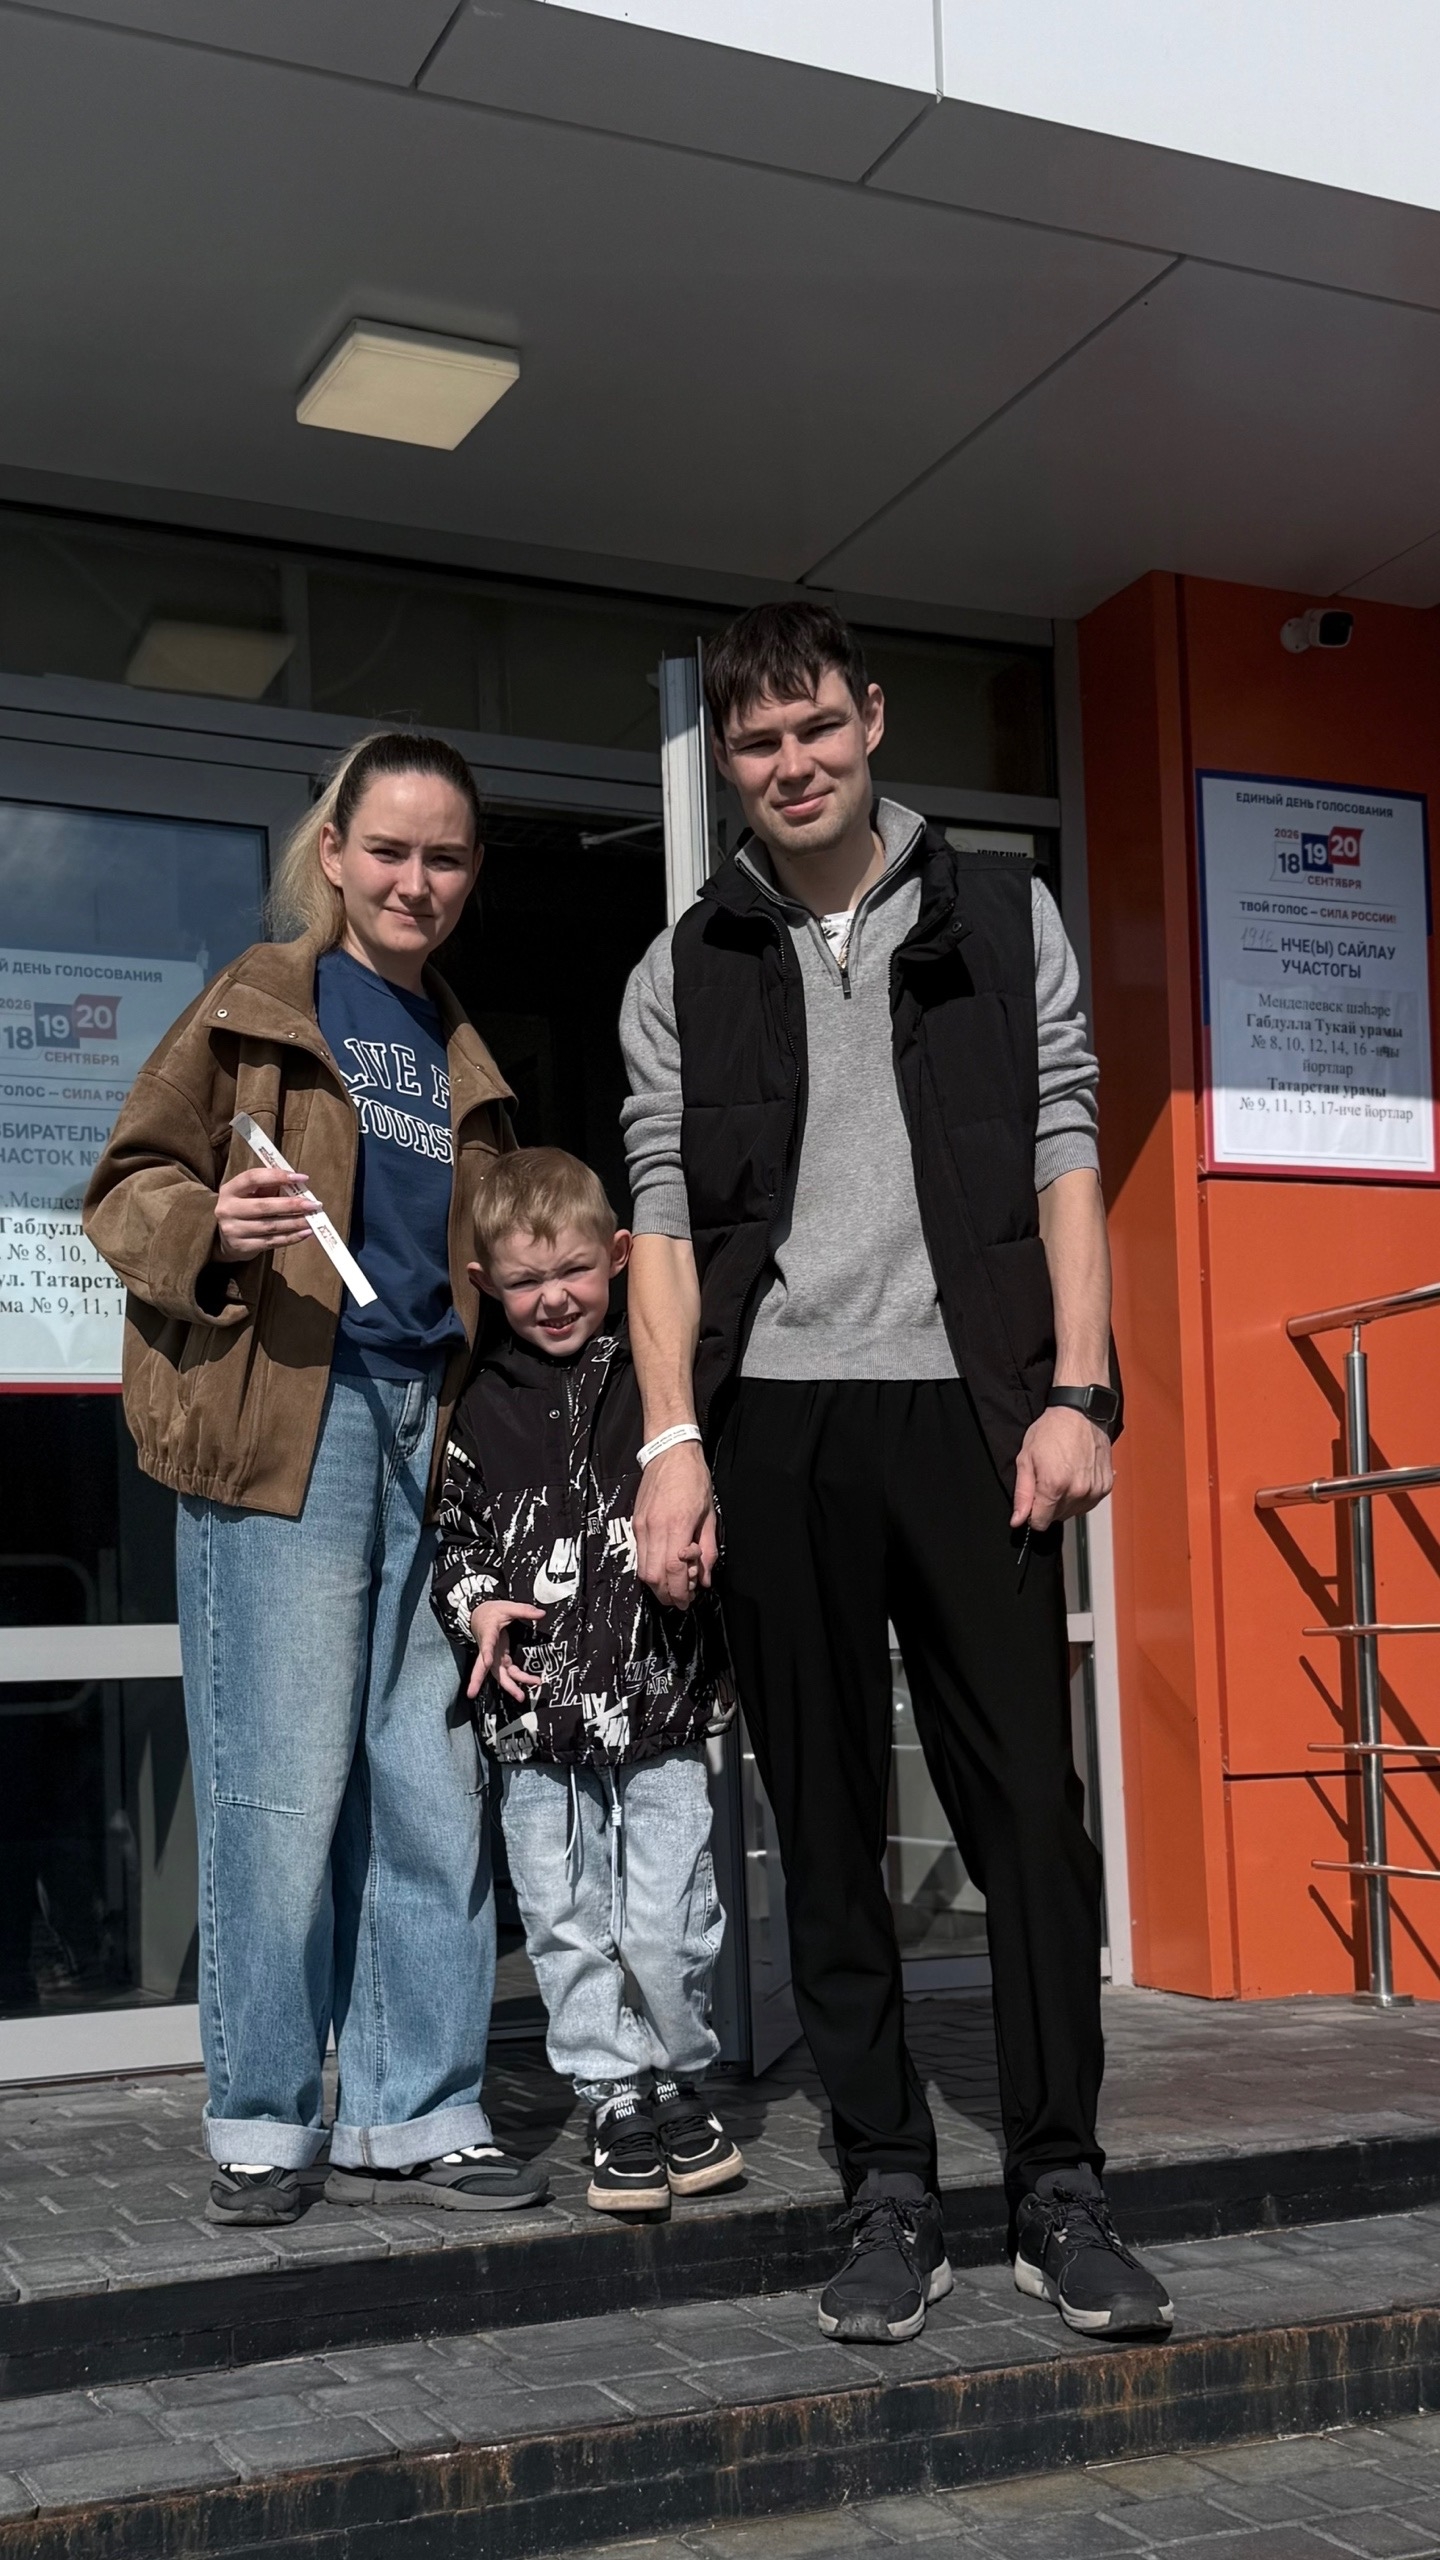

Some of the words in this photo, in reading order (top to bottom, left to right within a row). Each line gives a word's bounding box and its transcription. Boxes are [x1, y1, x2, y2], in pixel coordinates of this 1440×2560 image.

[1236, 792, 1283, 805] ЕДИНЫЙ
[1286, 797, 1314, 809] ДЕНЬ
[1316, 800, 1393, 818] ГОЛОСОВАНИЯ
[1274, 828, 1299, 839] 2026
[1278, 852, 1300, 874] 18
[1304, 843, 1328, 865] 19
[1331, 835, 1357, 858] 20
[1307, 875, 1362, 890] СЕНТЯБРЯ
[1240, 901, 1270, 913] ТВОЙ
[1272, 904, 1308, 916] ГОЛОС
[1320, 908, 1349, 920] СИЛА
[1351, 911, 1397, 924] РОССИИ!
[1281, 937, 1333, 958] НЧЕ(Ы)
[1337, 941, 1396, 960] САЙЛАУ
[13, 962, 51, 975] ДЕНЬ
[55, 965, 163, 983] ГОЛОСОВАНИЯ
[1281, 959, 1362, 979] УЧАСТОГЫ
[0, 998, 32, 1010] 2026
[1258, 993, 1343, 1013] Менделеевск
[3, 1025, 34, 1050] 18
[39, 1015, 70, 1039] 19
[76, 1004, 113, 1029] 20
[1246, 1014, 1312, 1032] Габдулла
[1315, 1018, 1356, 1036] Тукай
[1360, 1025, 1403, 1039] урамы
[1251, 1034, 1266, 1049] №
[1286, 1037, 1304, 1052] 10,
[1309, 1038, 1327, 1054] 12,
[1331, 1041, 1349, 1055] 14,
[44, 1051, 120, 1066] СЕНТЯБРЯ
[1302, 1059, 1354, 1078] йортлар
[62, 1088, 102, 1100] СИЛА
[1267, 1077, 1339, 1096] Татарстан
[1342, 1087, 1386, 1099] урамы
[1239, 1097, 1254, 1110] №
[1275, 1098, 1293, 1113] 11,
[1298, 1100, 1316, 1115] 13,
[1365, 1105, 1413, 1123] йортлар
[0, 1122, 111, 1142] БИРАТЕЛЬ
[349, 1093, 454, 1165] YOURS
[80, 1150, 99, 1167] №
[7, 1243, 29, 1260] №
[35, 1244, 52, 1264] 8,
[60, 1245, 86, 1265] 10,
[30, 1297, 52, 1314] №
[58, 1297, 75, 1317] 9,
[83, 1298, 108, 1317] 11,
